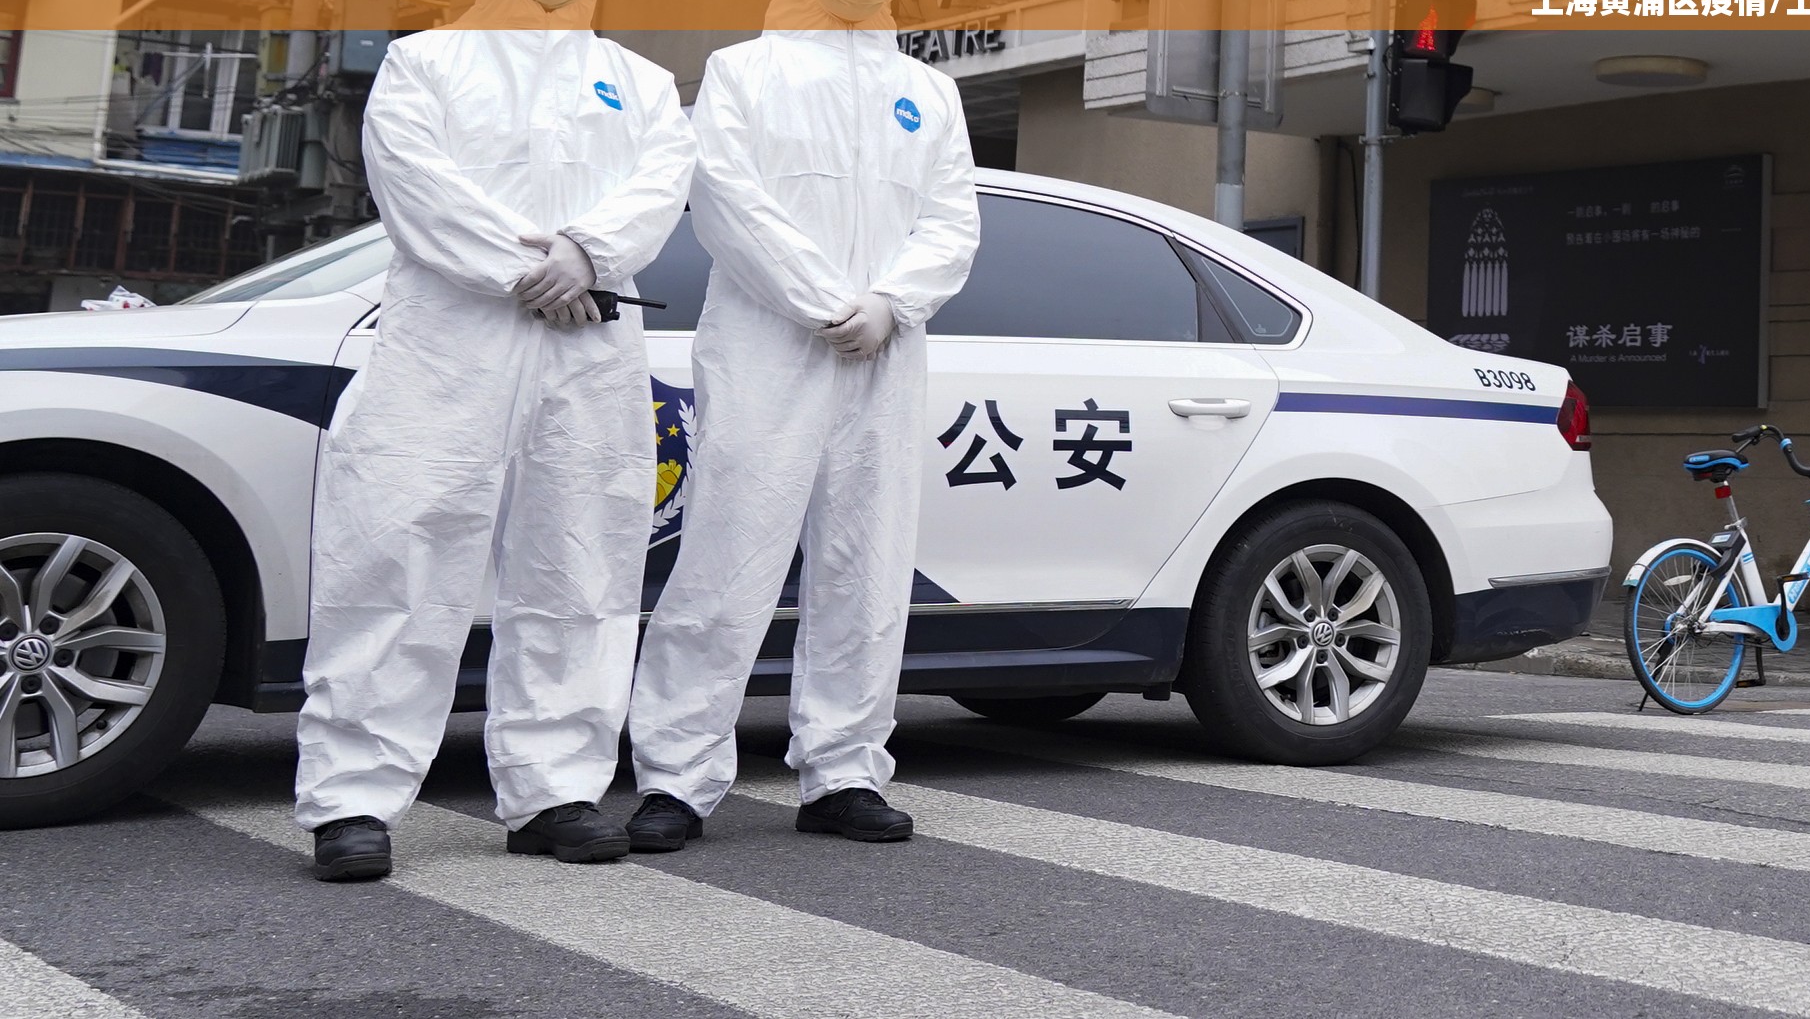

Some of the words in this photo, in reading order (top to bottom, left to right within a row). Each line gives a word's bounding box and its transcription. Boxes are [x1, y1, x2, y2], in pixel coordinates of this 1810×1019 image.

[1566, 322, 1673, 348] 谋杀启事
[1578, 354, 1606, 363] Murder
[1618, 353, 1667, 362] Announced
[1473, 368, 1536, 391] B3098
[937, 397, 1133, 491] 公安
